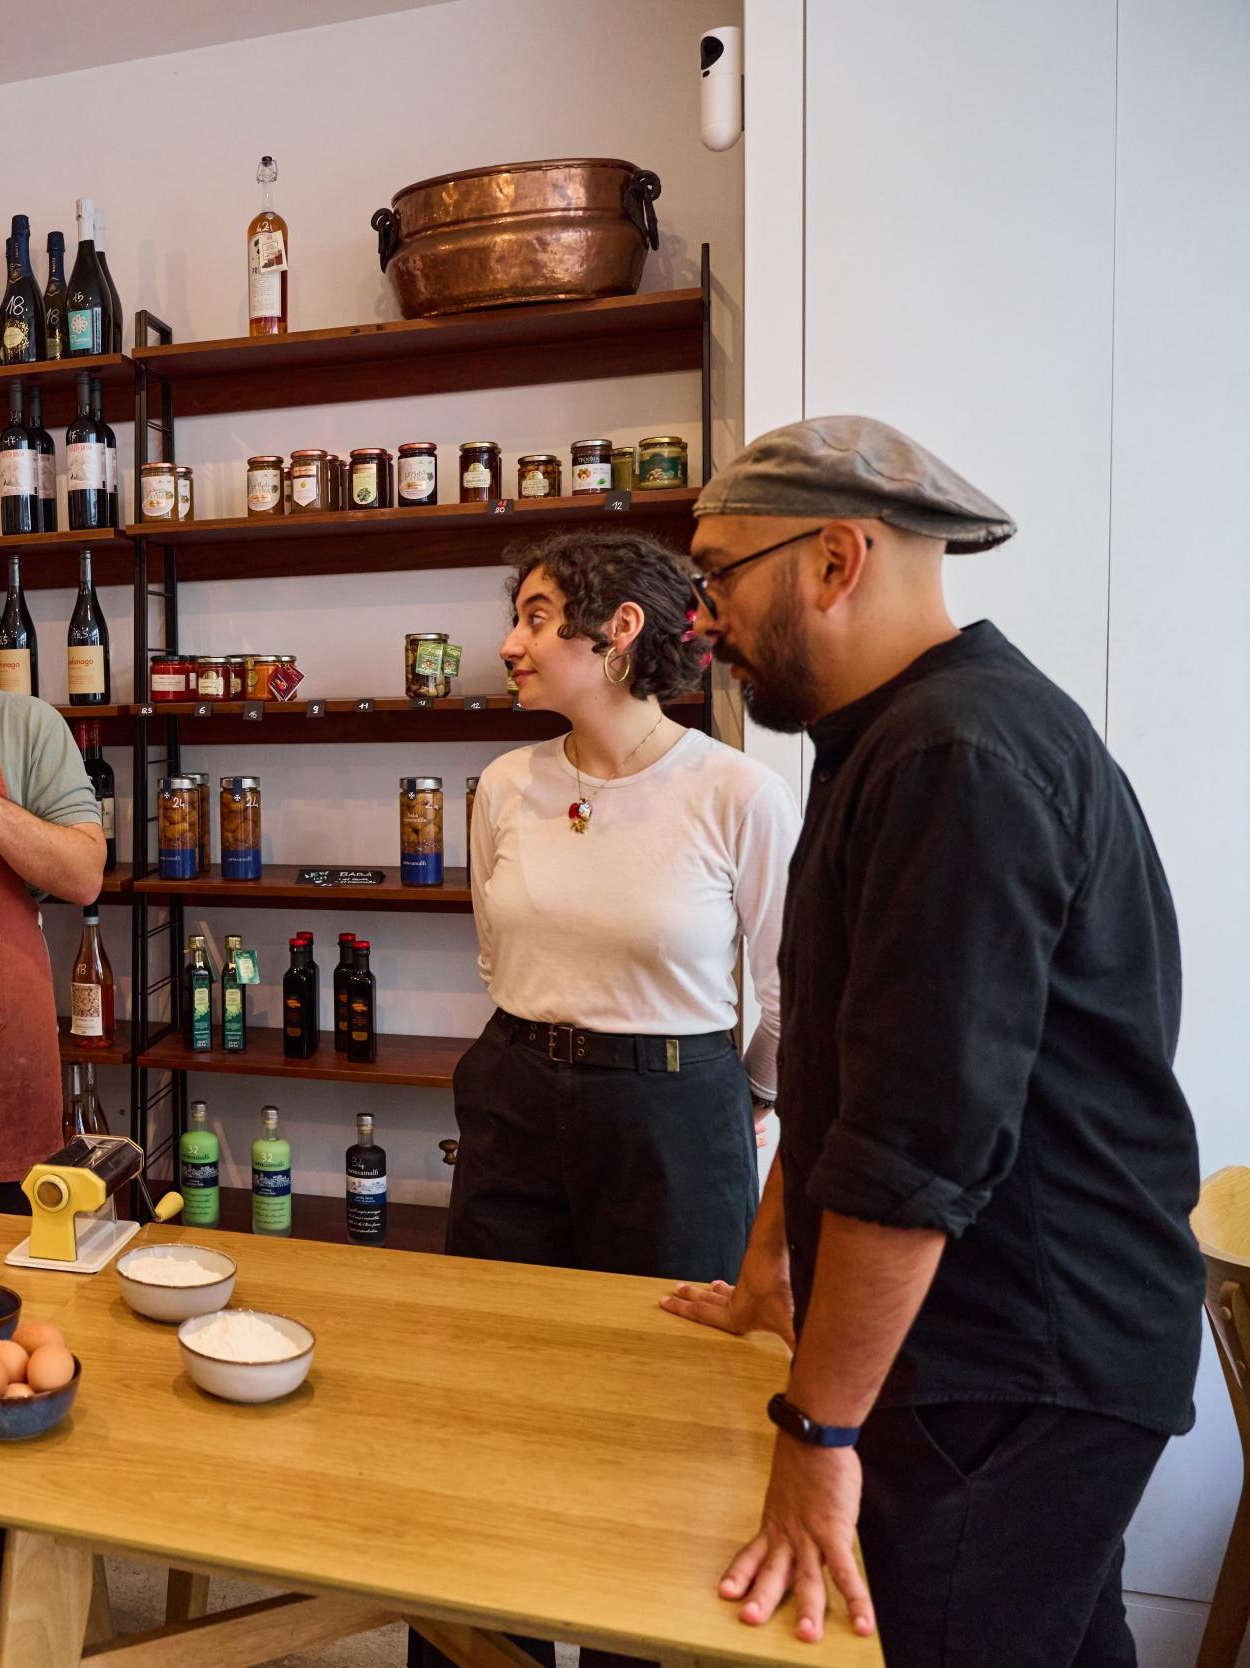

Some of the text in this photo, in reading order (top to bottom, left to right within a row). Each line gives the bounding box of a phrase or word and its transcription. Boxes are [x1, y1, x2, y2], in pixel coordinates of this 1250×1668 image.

[5, 295, 25, 316] 18
[45, 308, 60, 325] 18
[611, 501, 623, 510] 12
[198, 706, 206, 714] 6
[172, 797, 186, 810] 24
[76, 963, 87, 975] 18
[187, 1144, 199, 1155] 32
[261, 1152, 273, 1163] 32
